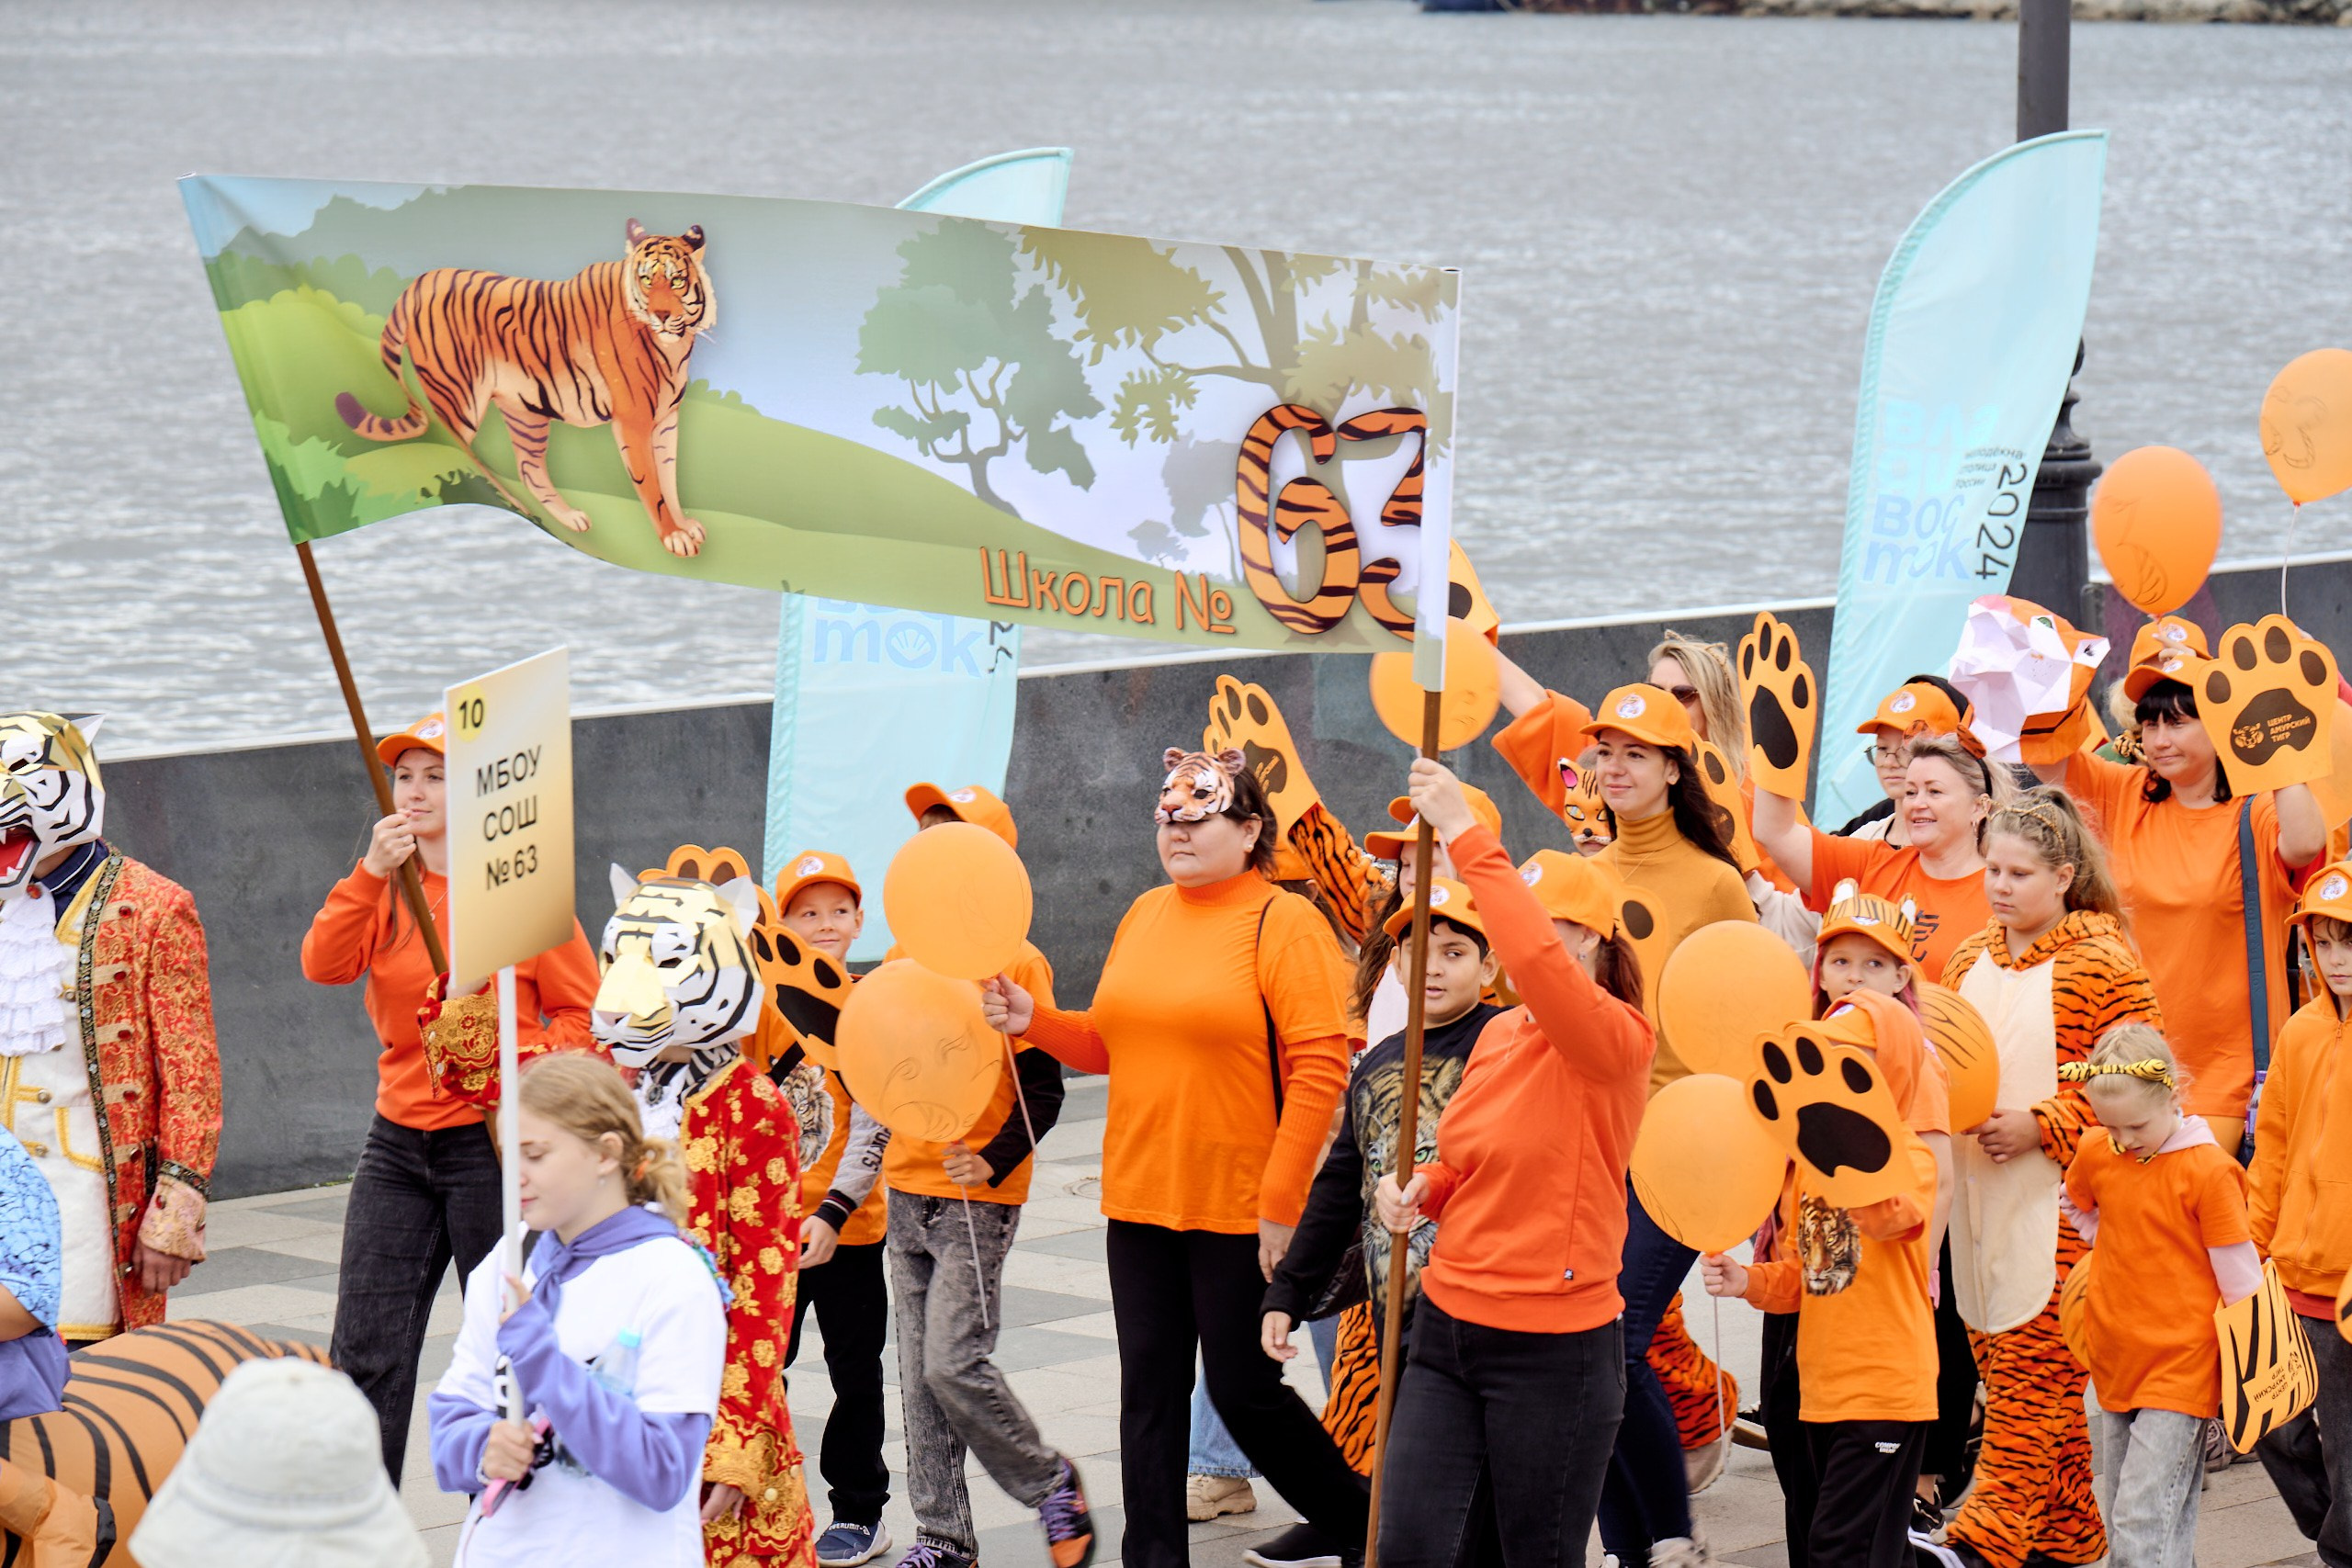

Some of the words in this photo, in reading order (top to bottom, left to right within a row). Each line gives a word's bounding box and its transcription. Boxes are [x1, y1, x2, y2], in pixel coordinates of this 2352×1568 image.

[980, 547, 1156, 625] Школа
[1174, 570, 1237, 635] №
[1236, 403, 1427, 642] 63
[1975, 462, 2028, 581] 2024
[457, 696, 485, 730] 10
[2267, 714, 2292, 727] ЦЕНТР
[2269, 716, 2311, 735] АМУРСКИЙ
[2271, 731, 2290, 742] ТИГР
[477, 745, 541, 797] МБОУ
[484, 795, 538, 842] СОШ
[2253, 1373, 2286, 1402] АМУРСКИЙ
[2271, 1366, 2284, 1380] ТИГР
[2271, 1382, 2289, 1400] ЦЕНТР
